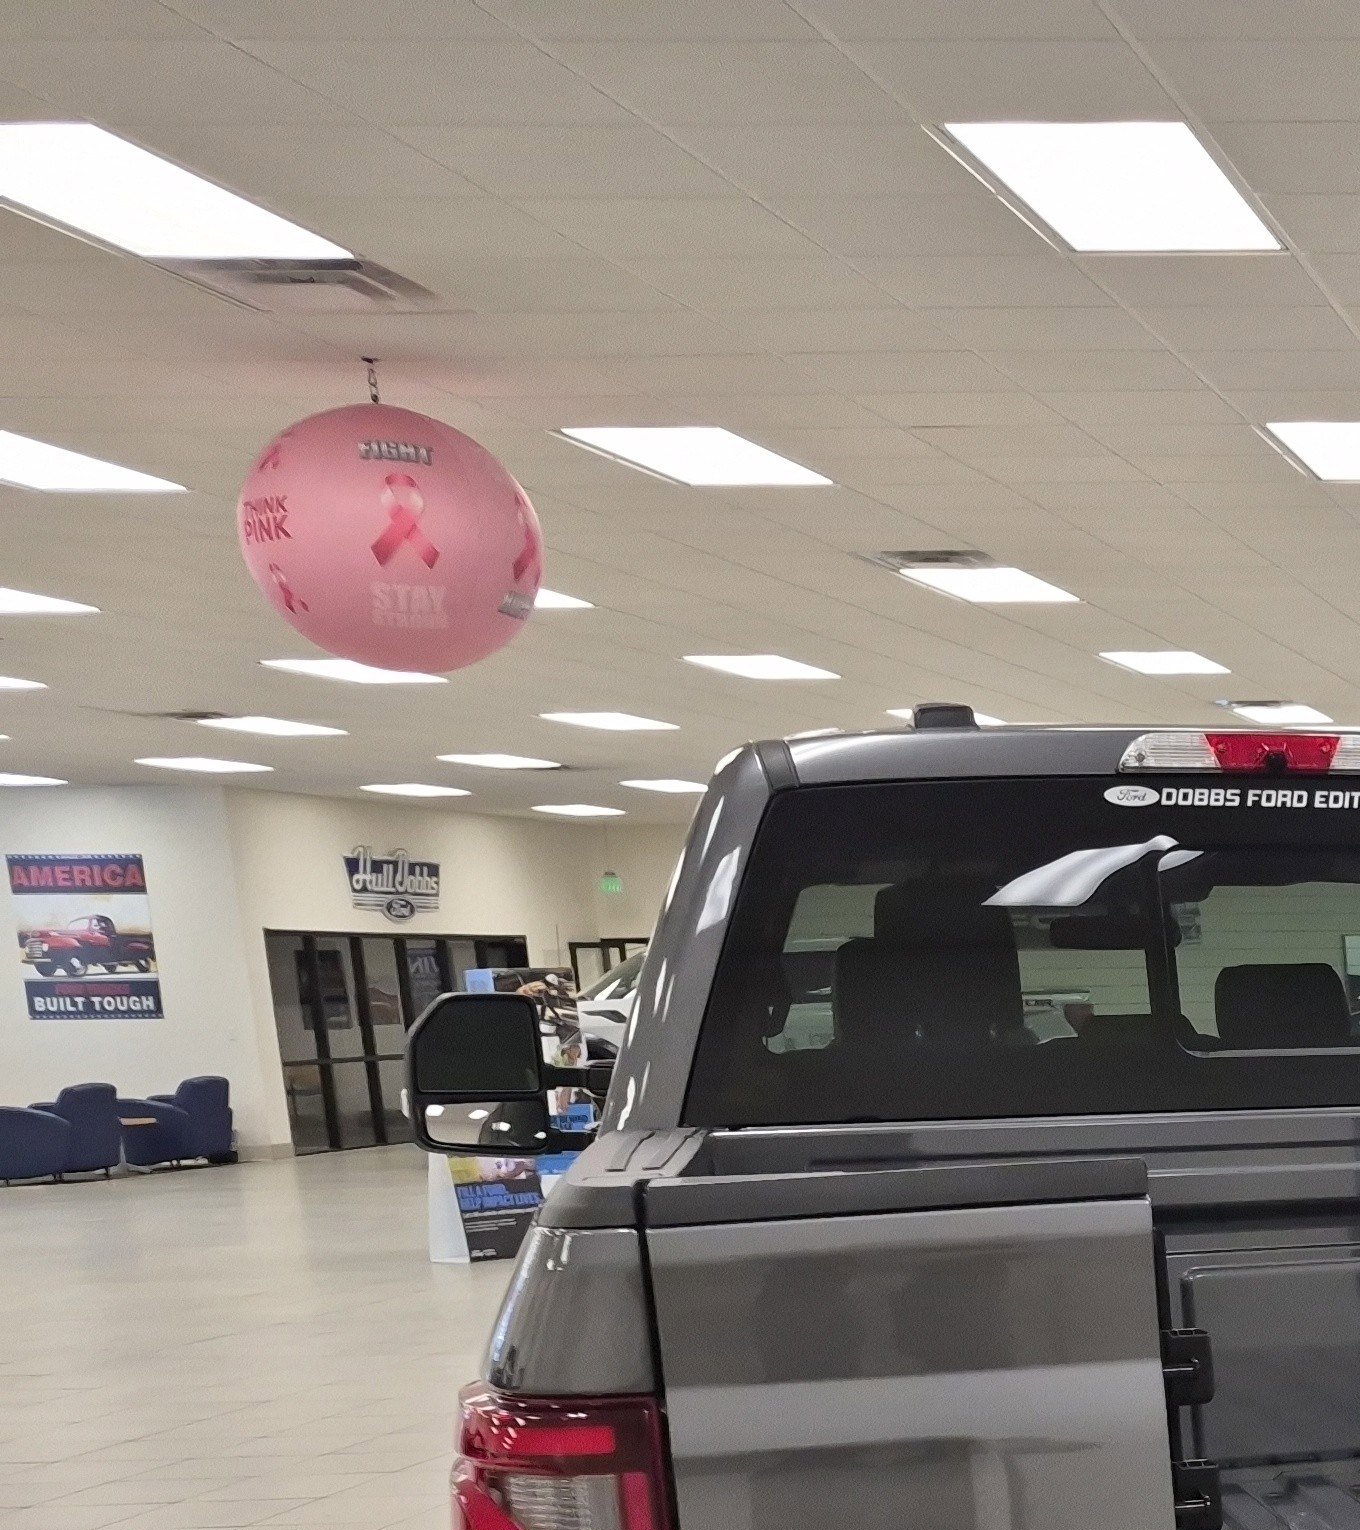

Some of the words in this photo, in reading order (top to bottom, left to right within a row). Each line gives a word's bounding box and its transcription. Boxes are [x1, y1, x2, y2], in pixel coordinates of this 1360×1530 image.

[243, 514, 293, 545] PINK
[1116, 788, 1147, 803] Ford
[1160, 787, 1241, 807] DOBBS
[1246, 789, 1309, 808] FORD
[12, 863, 146, 888] AMERICA
[33, 996, 87, 1012] BUILT
[90, 996, 157, 1012] TOUGH
